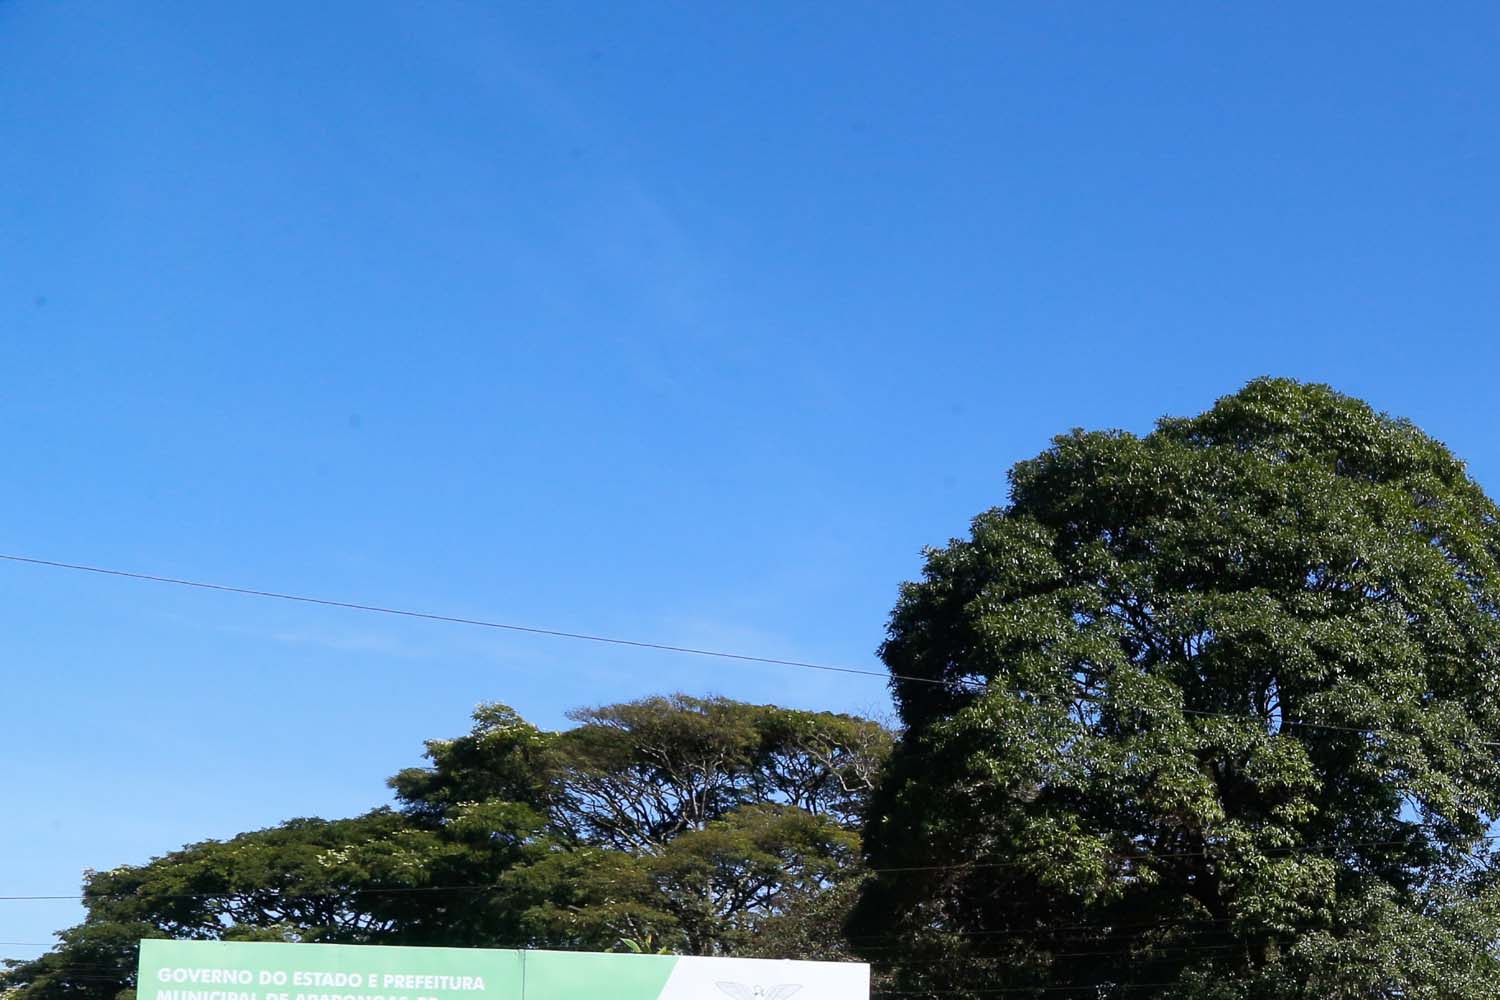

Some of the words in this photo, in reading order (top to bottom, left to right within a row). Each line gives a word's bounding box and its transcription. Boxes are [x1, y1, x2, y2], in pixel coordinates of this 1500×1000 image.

[157, 967, 253, 985] GOVERNO
[258, 970, 288, 986] DO
[293, 972, 363, 988] ESTADO
[368, 974, 377, 988] E
[383, 975, 485, 991] PREFEITURA
